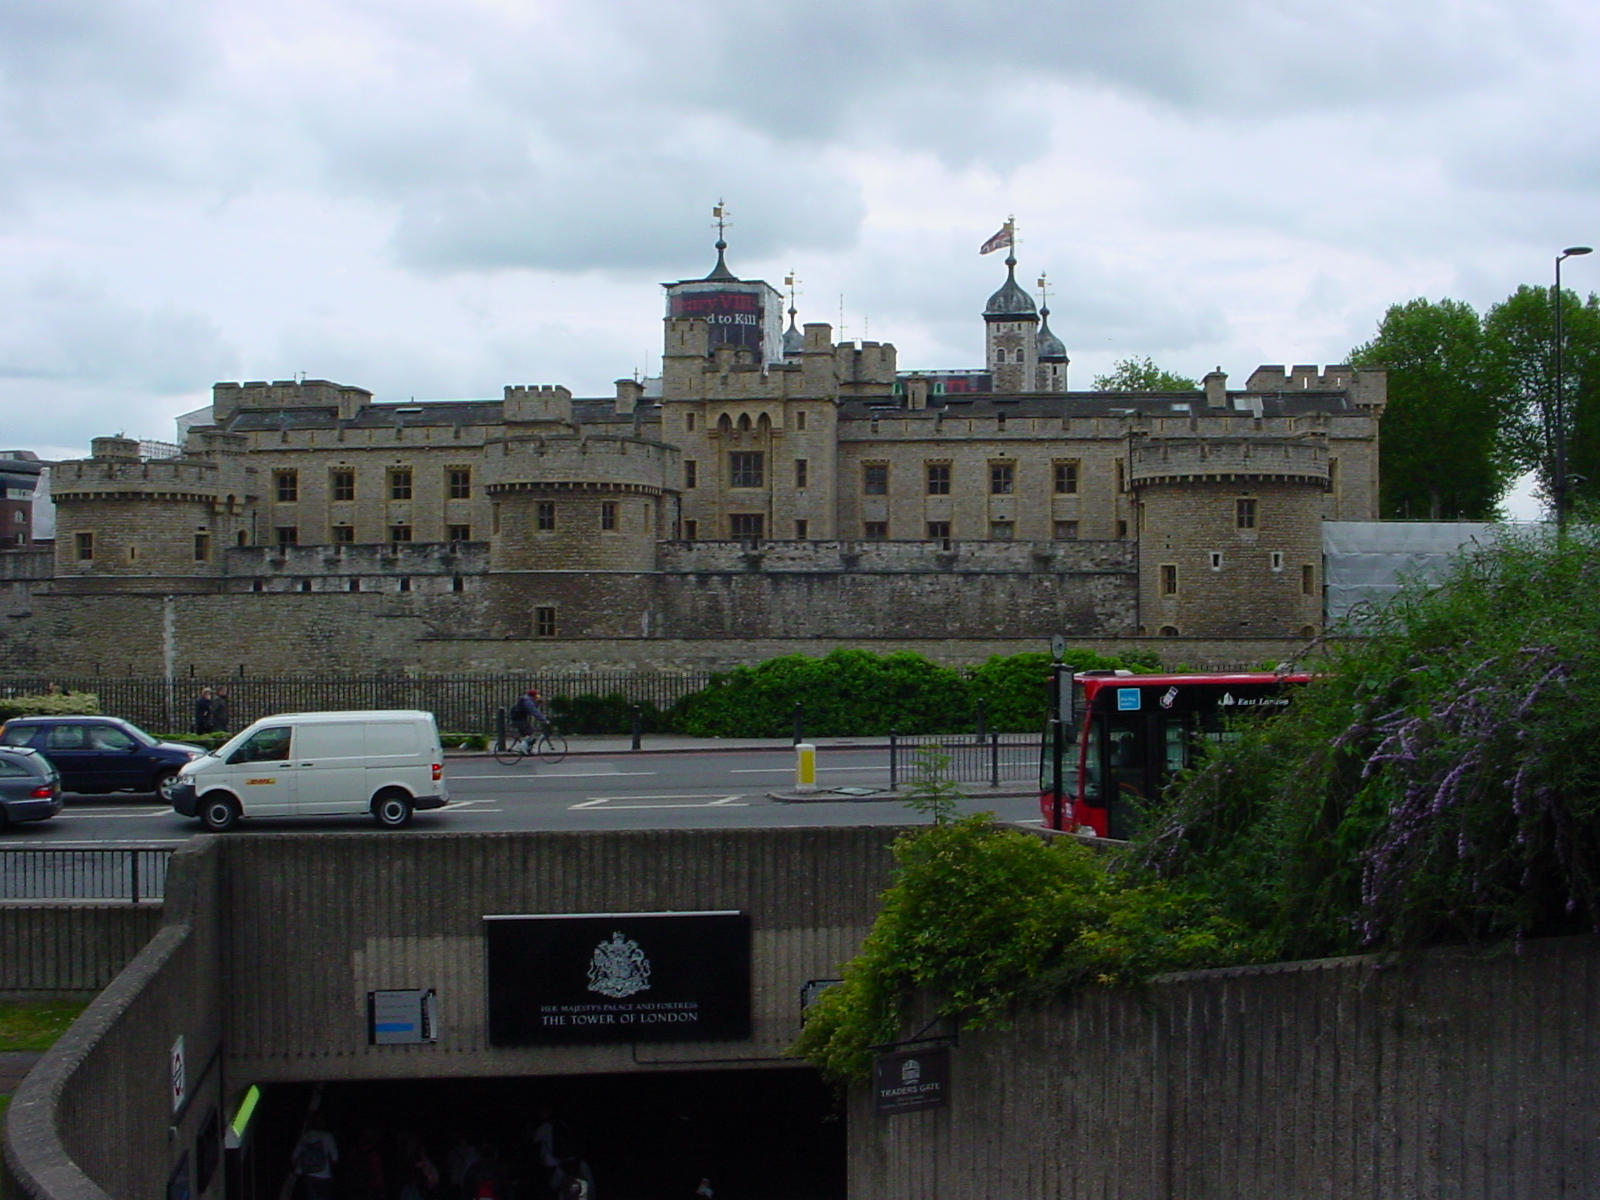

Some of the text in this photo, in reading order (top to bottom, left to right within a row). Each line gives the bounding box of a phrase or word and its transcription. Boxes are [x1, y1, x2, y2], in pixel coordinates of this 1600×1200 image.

[718, 314, 732, 324] to
[735, 313, 757, 325] Kill
[656, 1002, 698, 1010] FORTRESS
[541, 1012, 698, 1025] THE TOWER OF LONDON
[881, 1082, 940, 1097] TRADERS GATE
